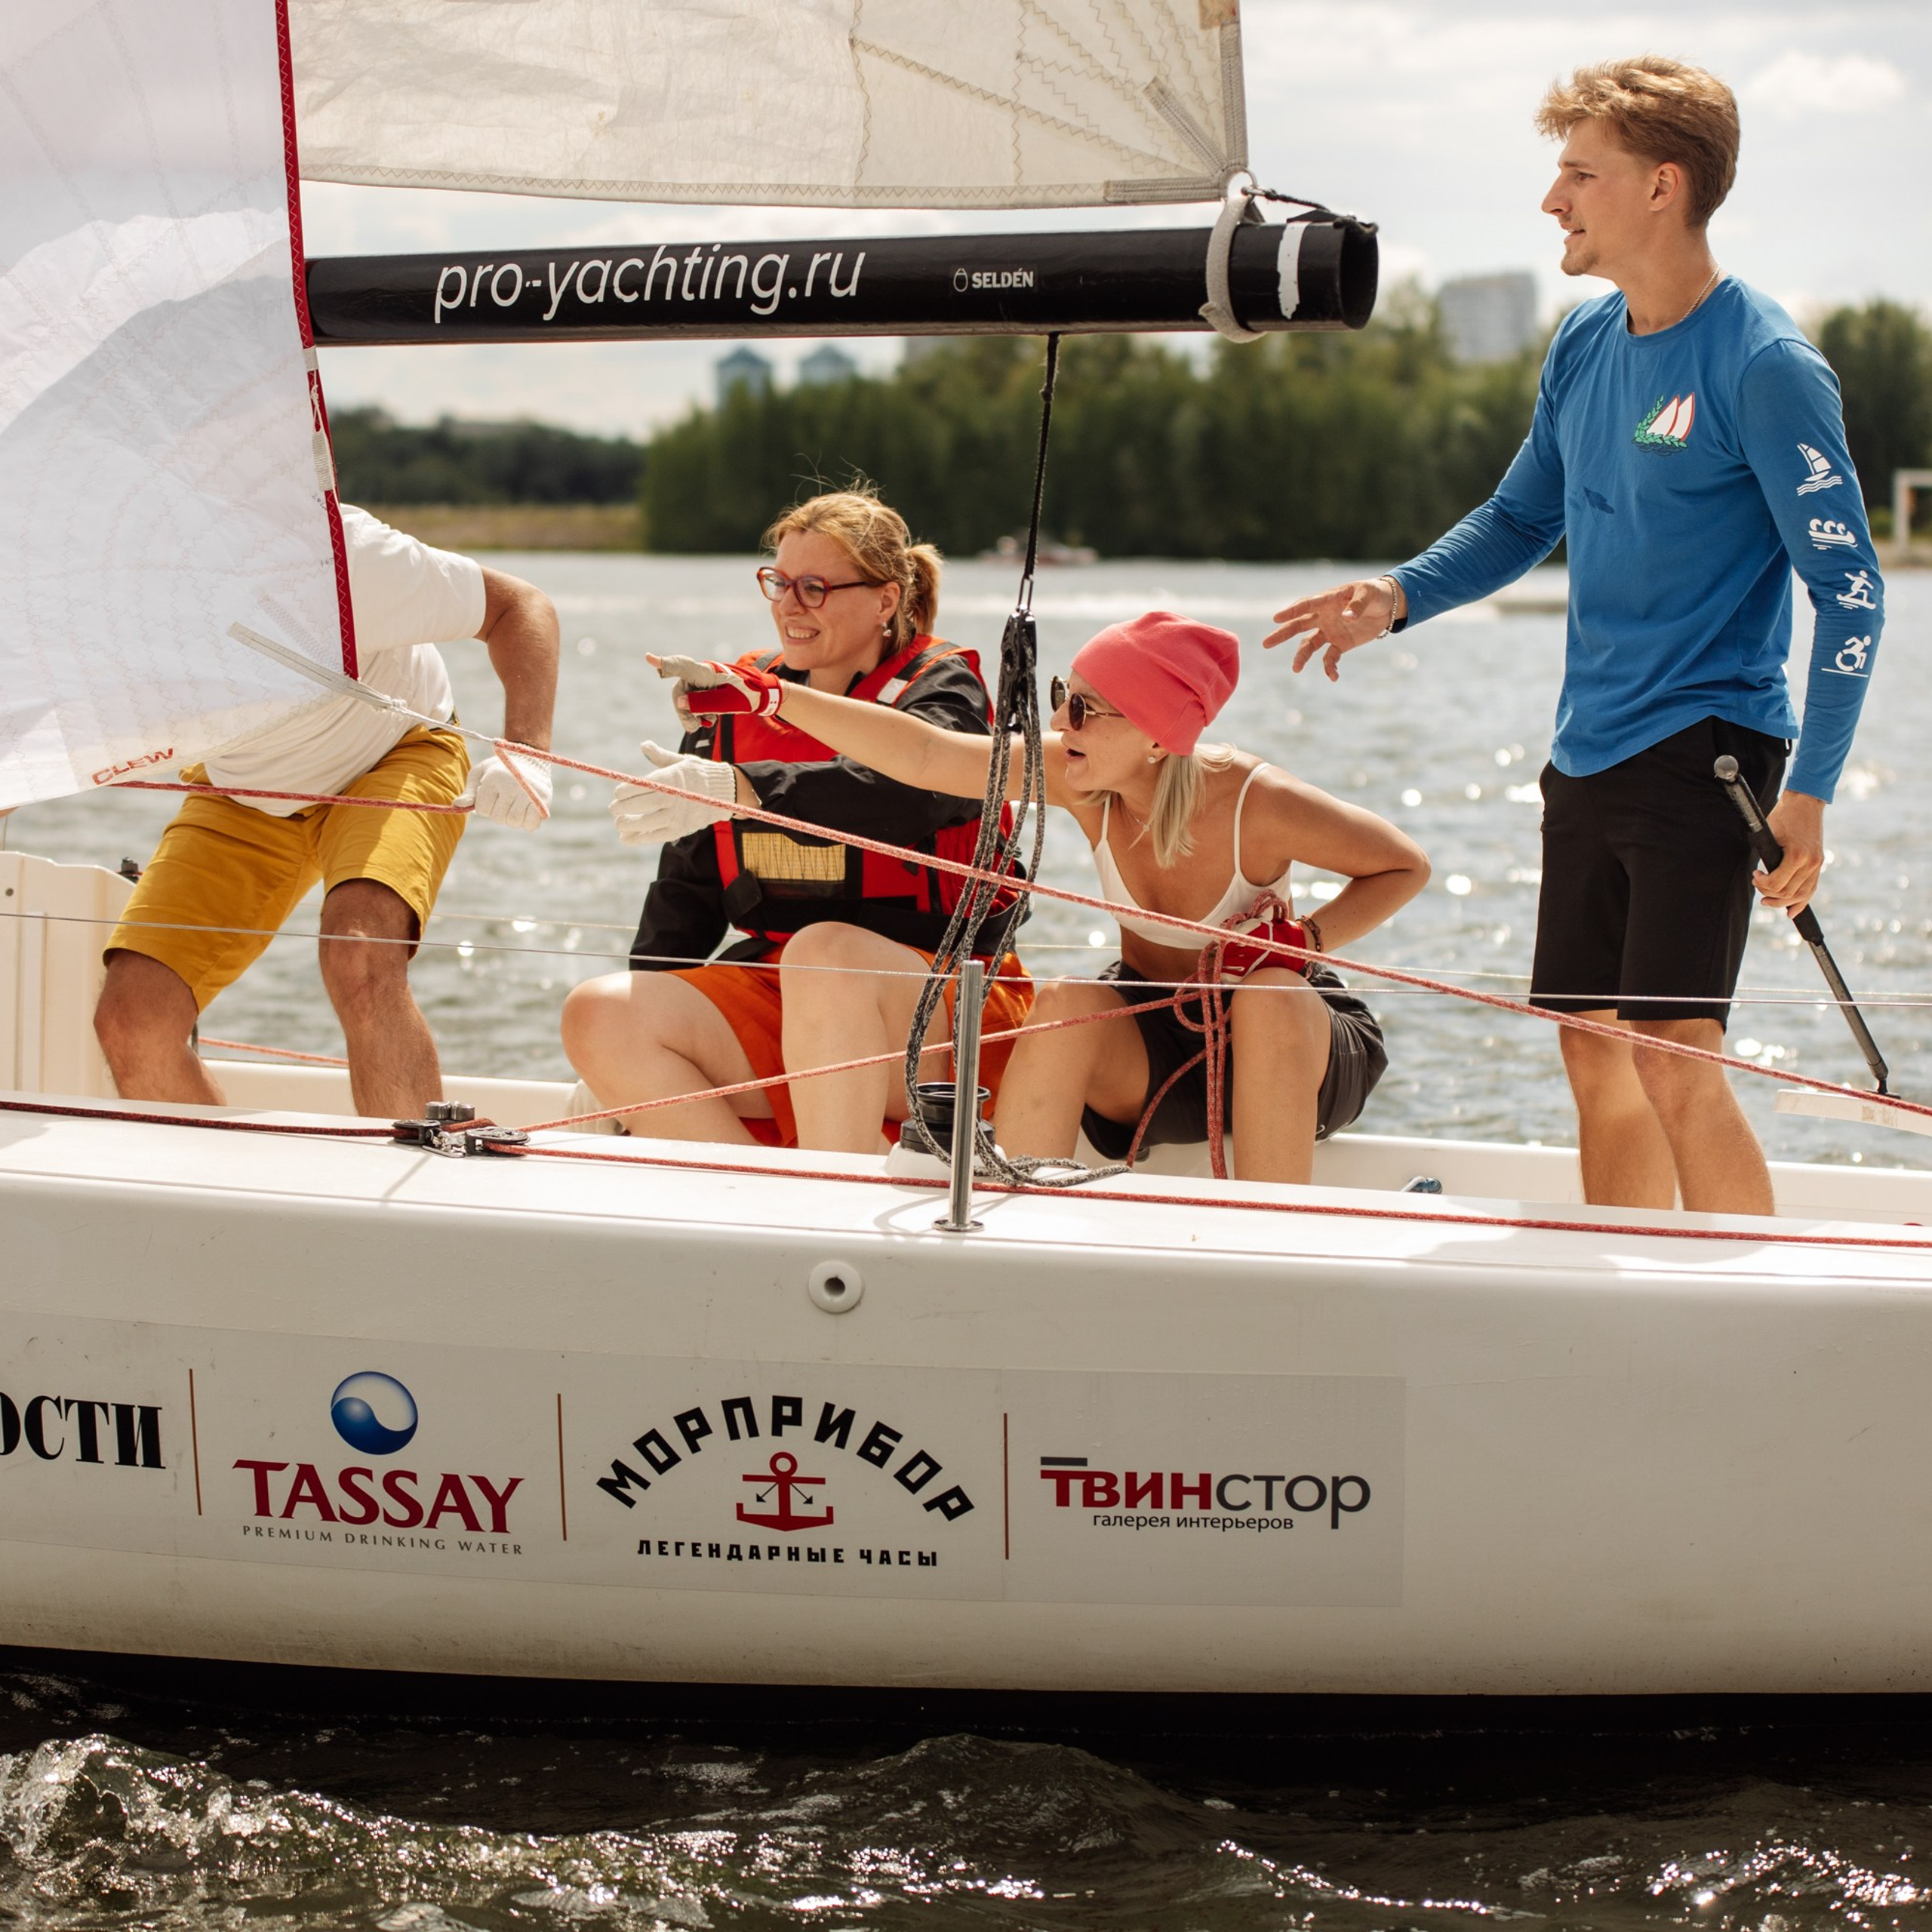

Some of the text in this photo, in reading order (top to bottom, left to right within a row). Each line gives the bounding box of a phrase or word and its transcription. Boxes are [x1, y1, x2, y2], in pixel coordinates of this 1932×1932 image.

[435, 243, 866, 324] pro-yachting.ru
[971, 267, 1034, 289] SELDÉN
[91, 747, 174, 786] CLEW
[595, 1395, 975, 1522] МОРПРИБОР
[232, 1459, 526, 1534] TASSAY
[242, 1524, 523, 1555] PREMIUM DRINKING WATER
[1093, 1514, 1294, 1534] галерея интерьеров
[637, 1539, 937, 1567] ЛЕГЕНДАРНЫЕ ЧАСЫ
